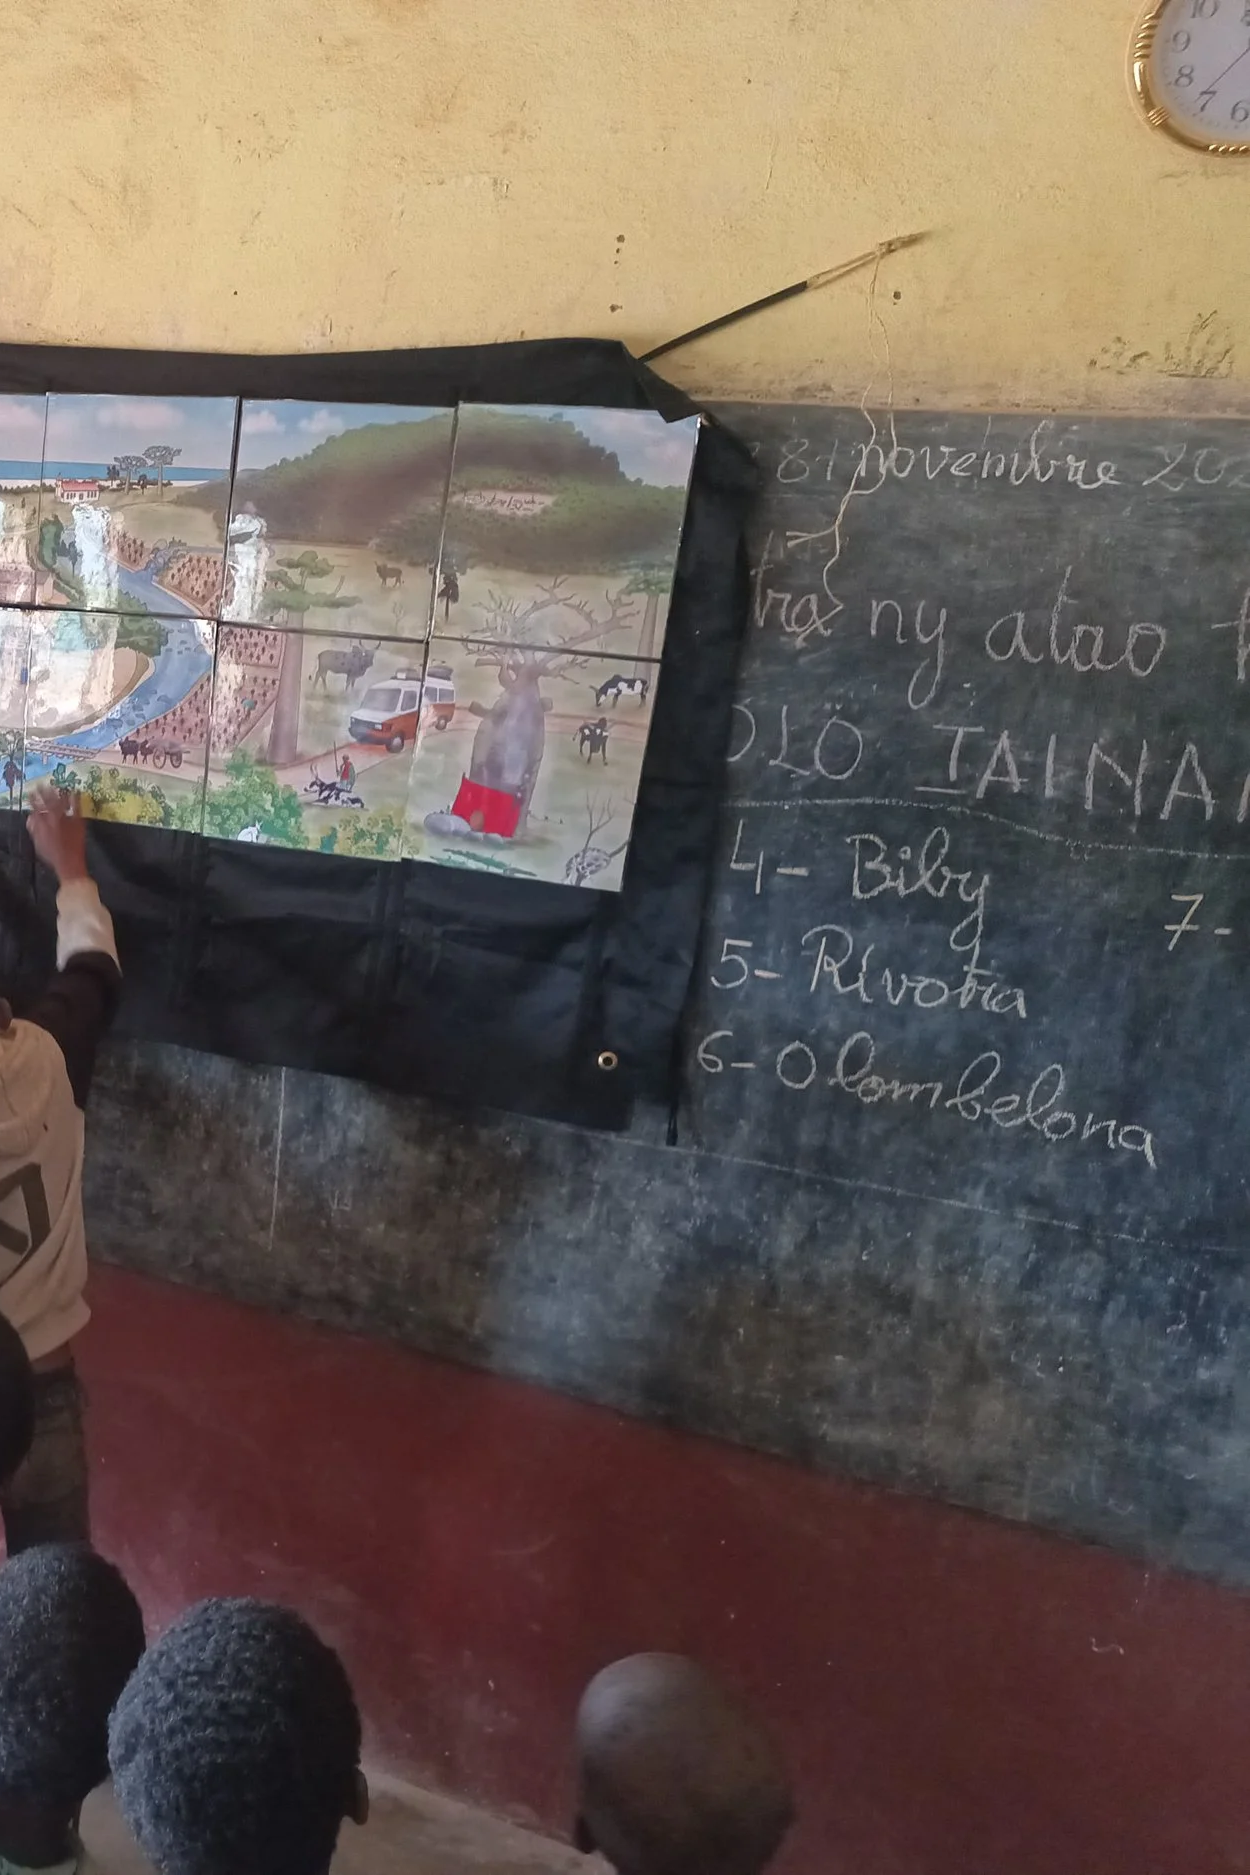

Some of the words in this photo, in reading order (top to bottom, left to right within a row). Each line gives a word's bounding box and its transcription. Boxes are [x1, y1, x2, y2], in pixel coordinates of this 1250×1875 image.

[1172, 30, 1191, 53] 9
[1174, 65, 1194, 88] 8
[1199, 91, 1218, 113] 7
[1230, 100, 1249, 122] 6
[871, 599, 948, 710] ny
[986, 565, 1167, 678] atao
[845, 827, 990, 951] Biby
